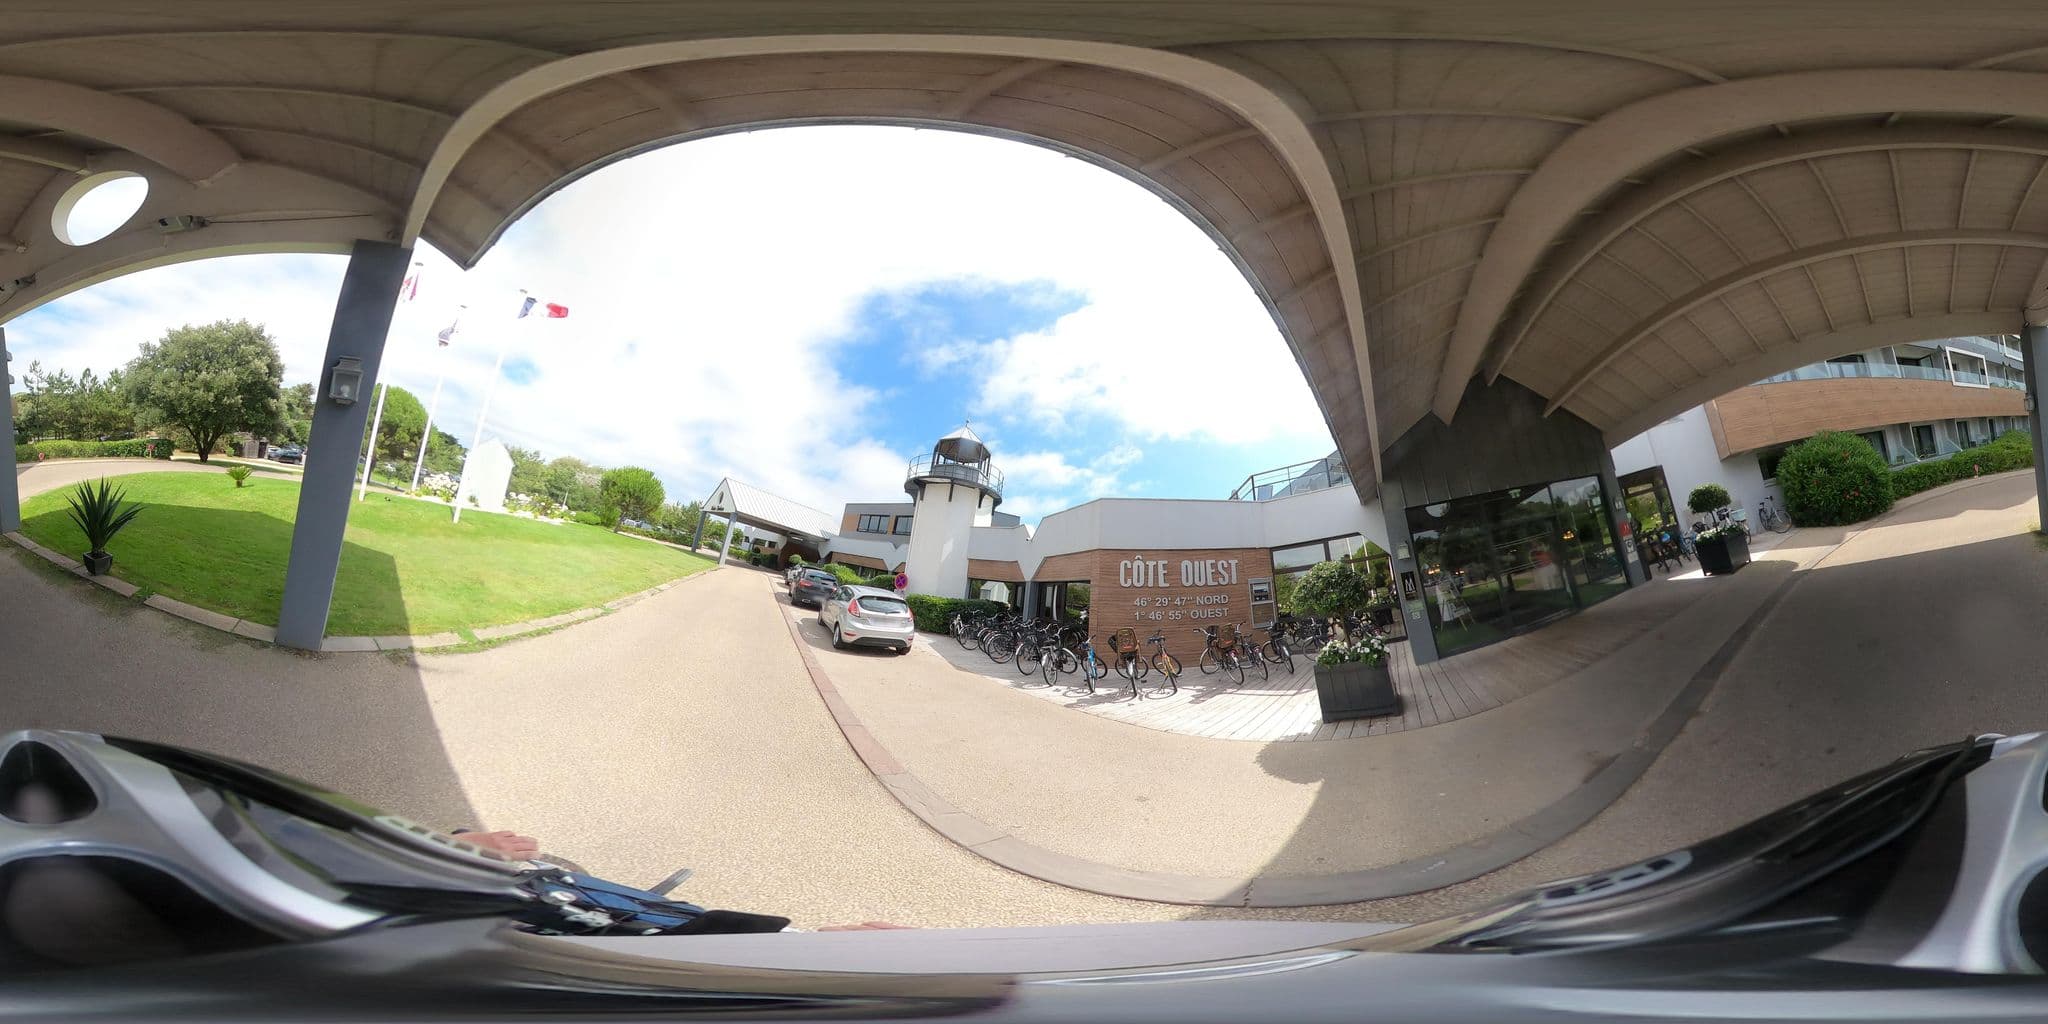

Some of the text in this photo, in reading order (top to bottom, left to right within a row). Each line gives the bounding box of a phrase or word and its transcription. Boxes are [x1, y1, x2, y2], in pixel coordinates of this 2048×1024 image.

[1119, 555, 1238, 588] CÔTE OUEST
[1134, 596, 1151, 607] 46°
[1155, 596, 1171, 607] 29'
[1196, 594, 1229, 606] NORD
[1134, 611, 1146, 621] 1°
[1149, 610, 1165, 621] 46'
[1190, 608, 1229, 619] OUEST
